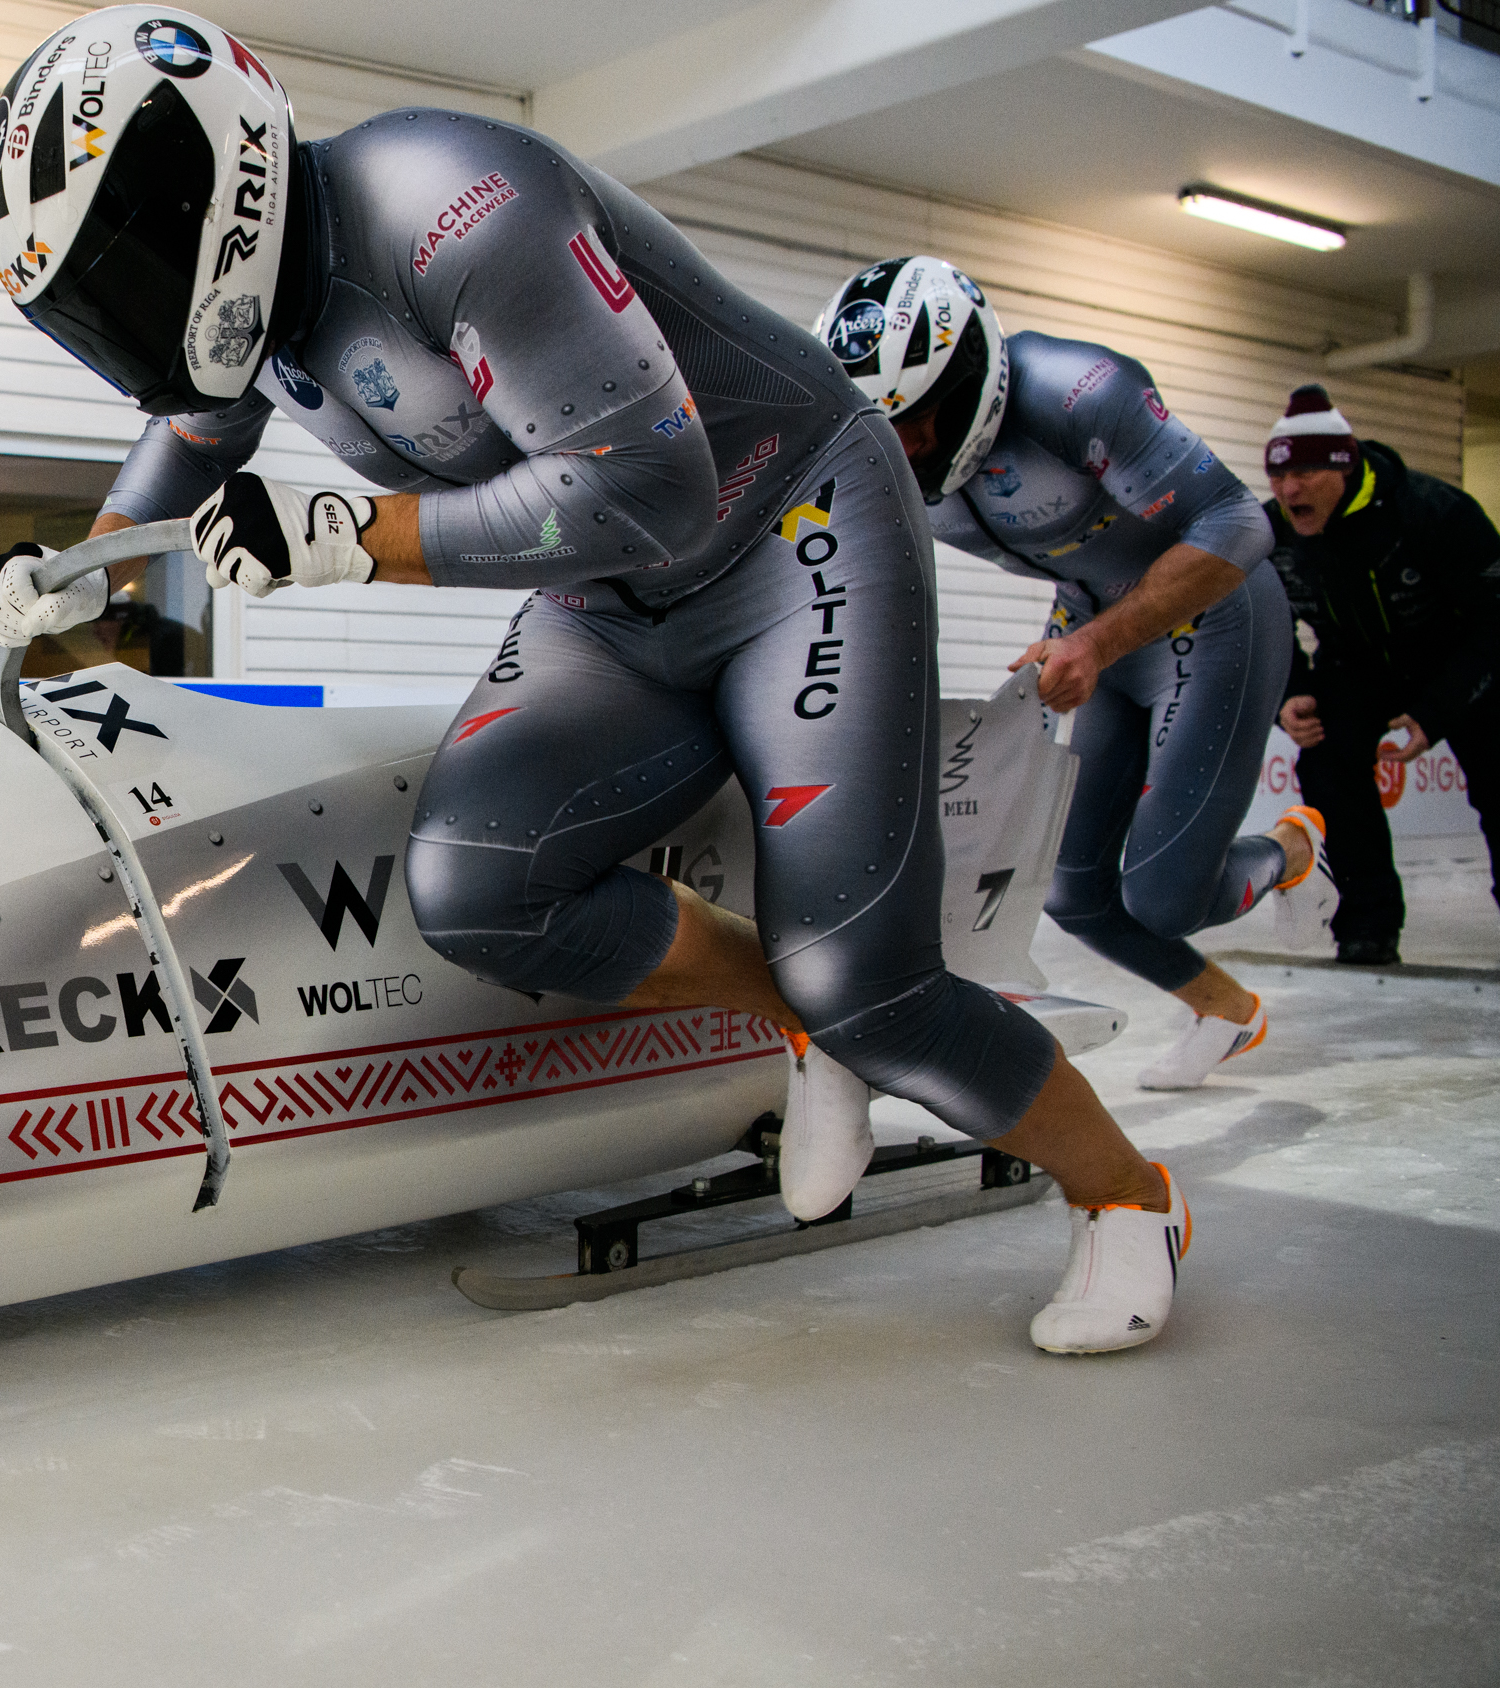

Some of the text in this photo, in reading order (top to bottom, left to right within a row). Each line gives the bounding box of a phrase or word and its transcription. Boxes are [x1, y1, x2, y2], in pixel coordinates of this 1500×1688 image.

[18, 35, 76, 120] Binders
[69, 40, 112, 172] WOLTEC
[234, 114, 267, 222] RIX
[266, 123, 279, 226] RIGA AIRPORT
[412, 171, 509, 276] MACHINE
[453, 187, 519, 241] RACEWEAR
[186, 288, 221, 371] FREEPORT OF RIGA
[897, 267, 925, 309] Binders
[128, 781, 174, 815] 14
[297, 973, 423, 1017] WOLTEC
